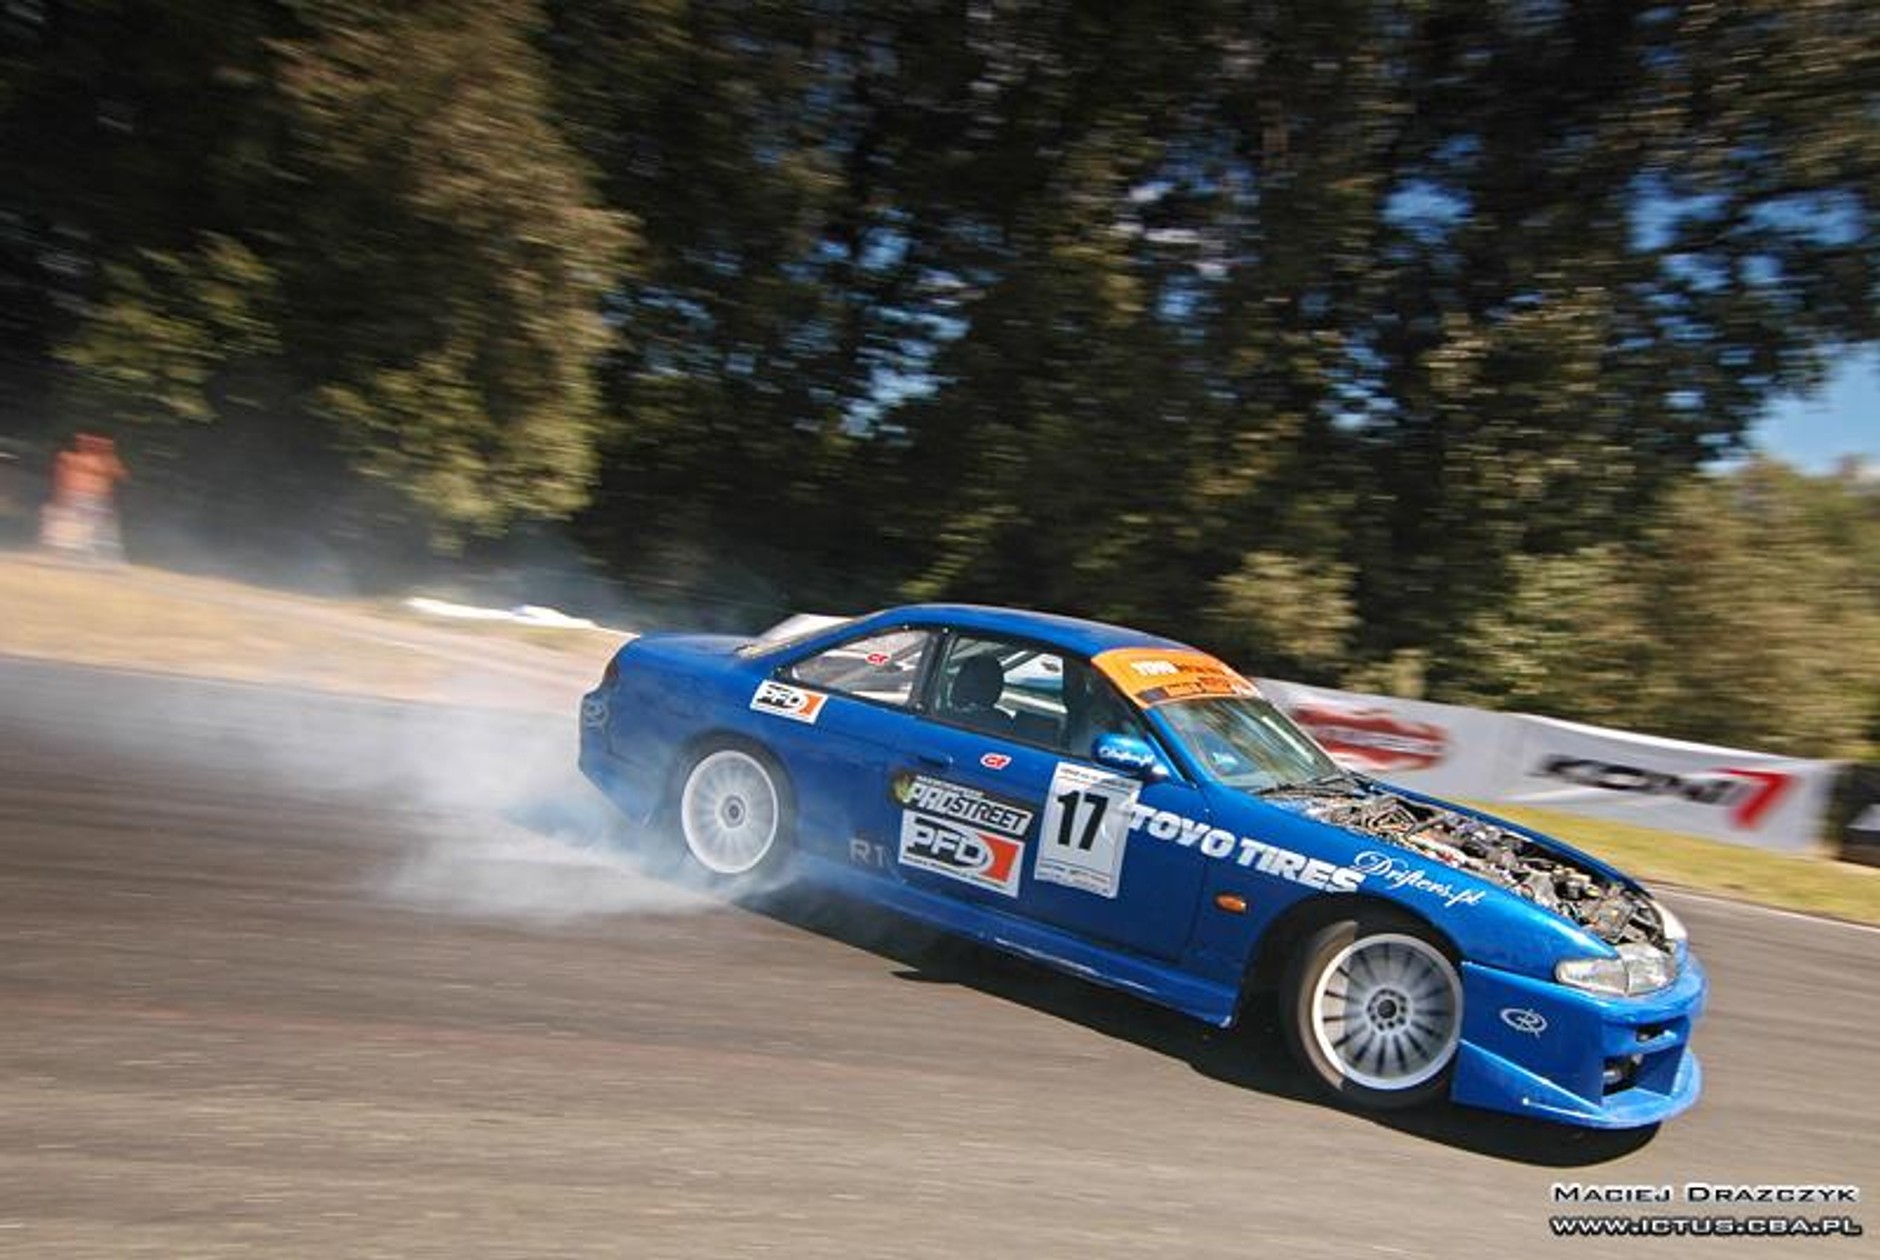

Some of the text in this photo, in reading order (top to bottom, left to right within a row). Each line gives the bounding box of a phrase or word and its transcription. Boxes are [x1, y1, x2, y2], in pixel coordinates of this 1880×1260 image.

[905, 823, 988, 866] PFD
[1057, 790, 1110, 851] 17
[1123, 803, 1367, 892] TOYO TIRES
